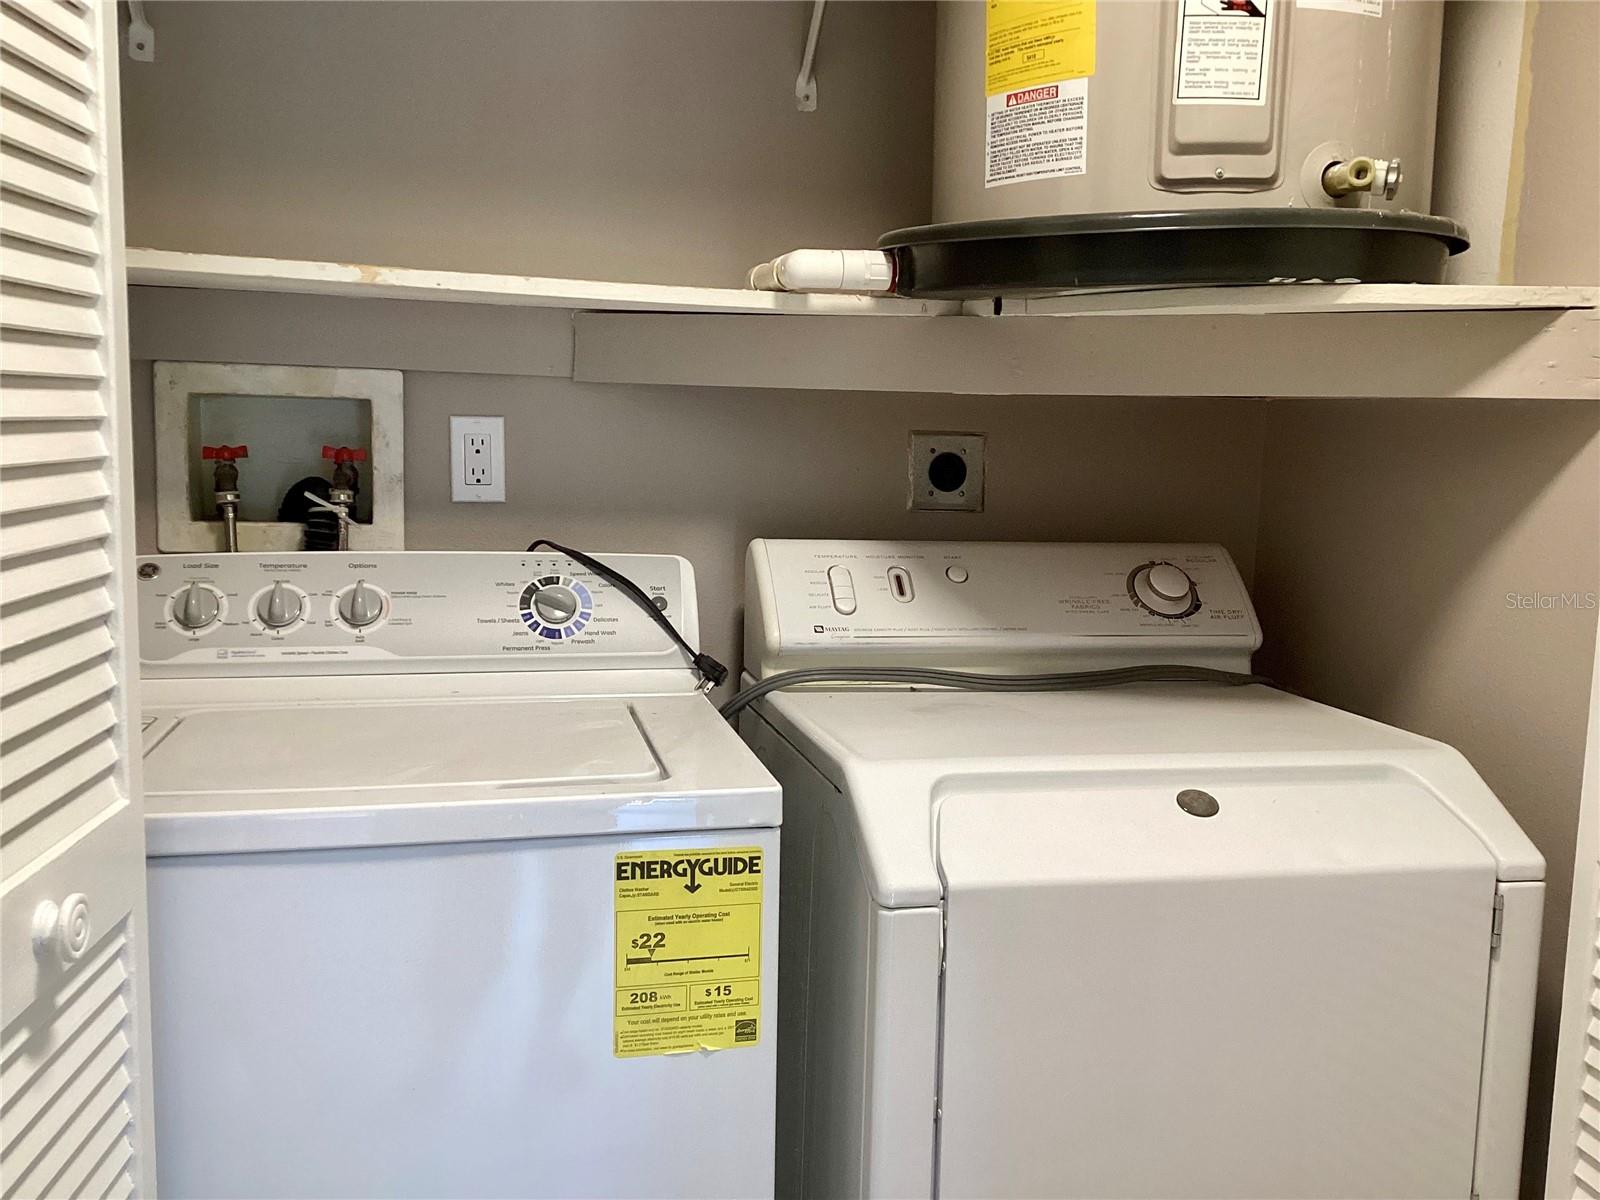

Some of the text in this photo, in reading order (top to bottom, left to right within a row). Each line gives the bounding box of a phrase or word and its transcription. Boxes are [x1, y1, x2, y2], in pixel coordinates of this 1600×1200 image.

[1018, 87, 1056, 103] DANGER
[616, 856, 761, 881] ENERGYGUIDE
[631, 932, 666, 949] $22
[630, 992, 658, 1004] 208
